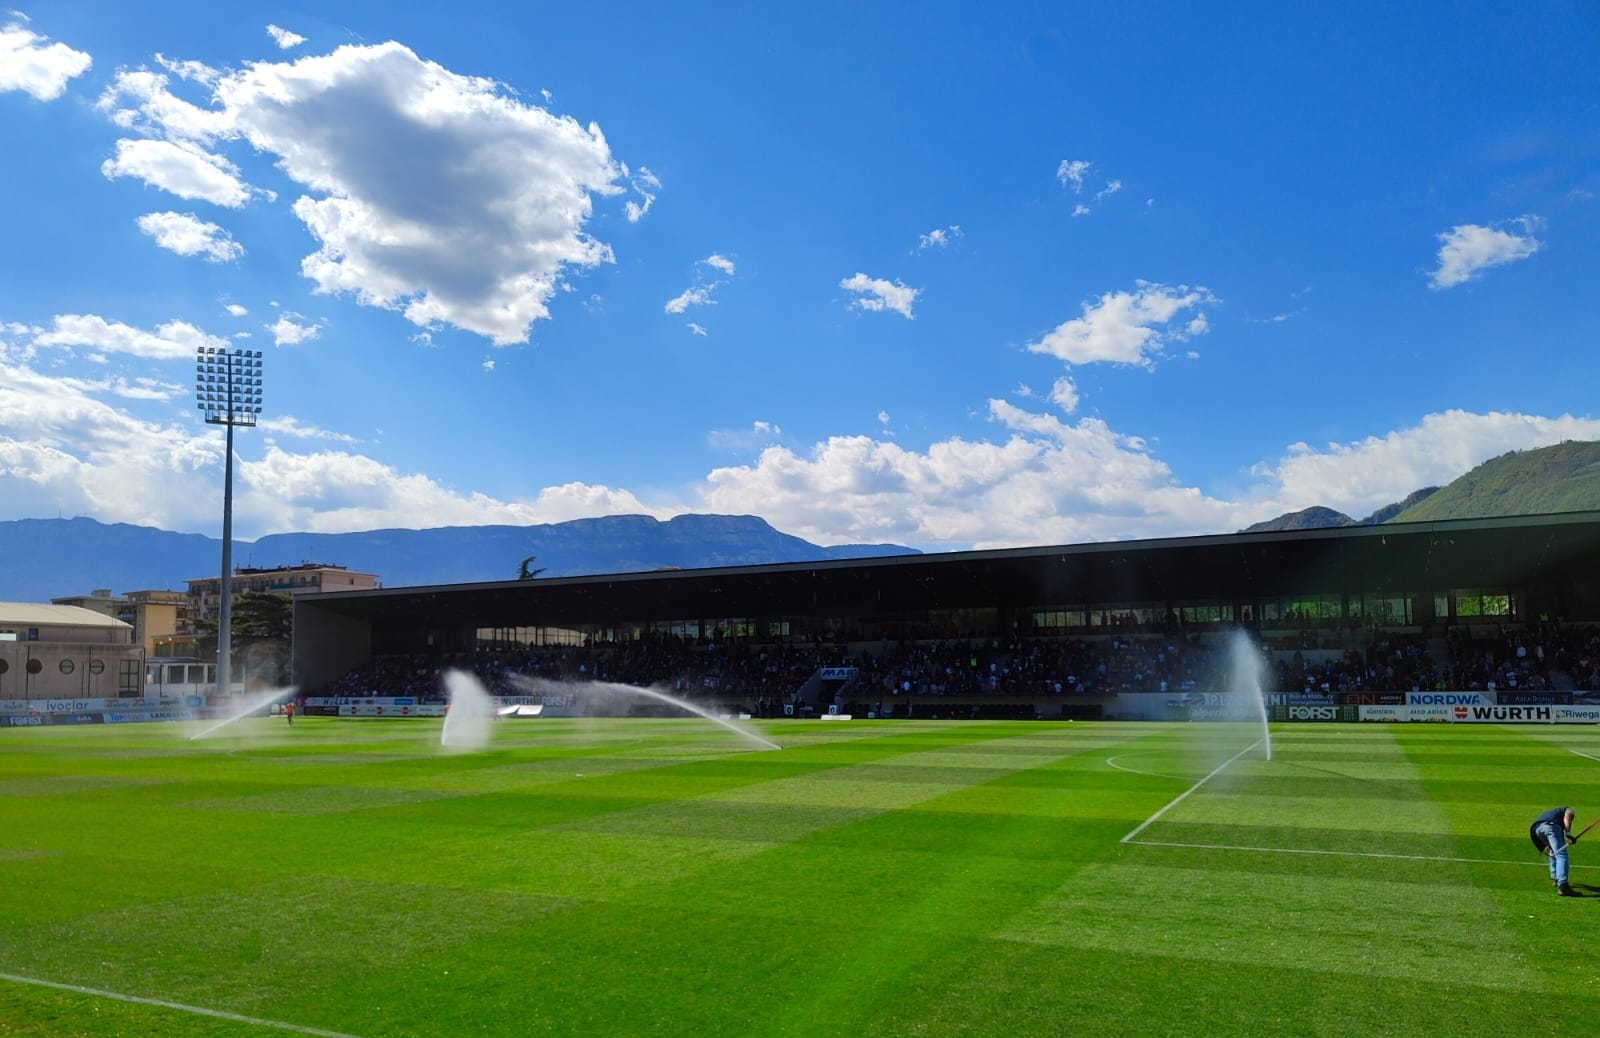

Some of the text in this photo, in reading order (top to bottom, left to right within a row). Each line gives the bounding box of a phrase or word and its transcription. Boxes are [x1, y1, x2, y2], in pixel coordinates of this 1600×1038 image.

[46, 700, 89, 711] ivoclar
[1288, 706, 1340, 720] FORST
[1472, 706, 1551, 720] WÜRTH
[1565, 709, 1600, 720] Riwega
